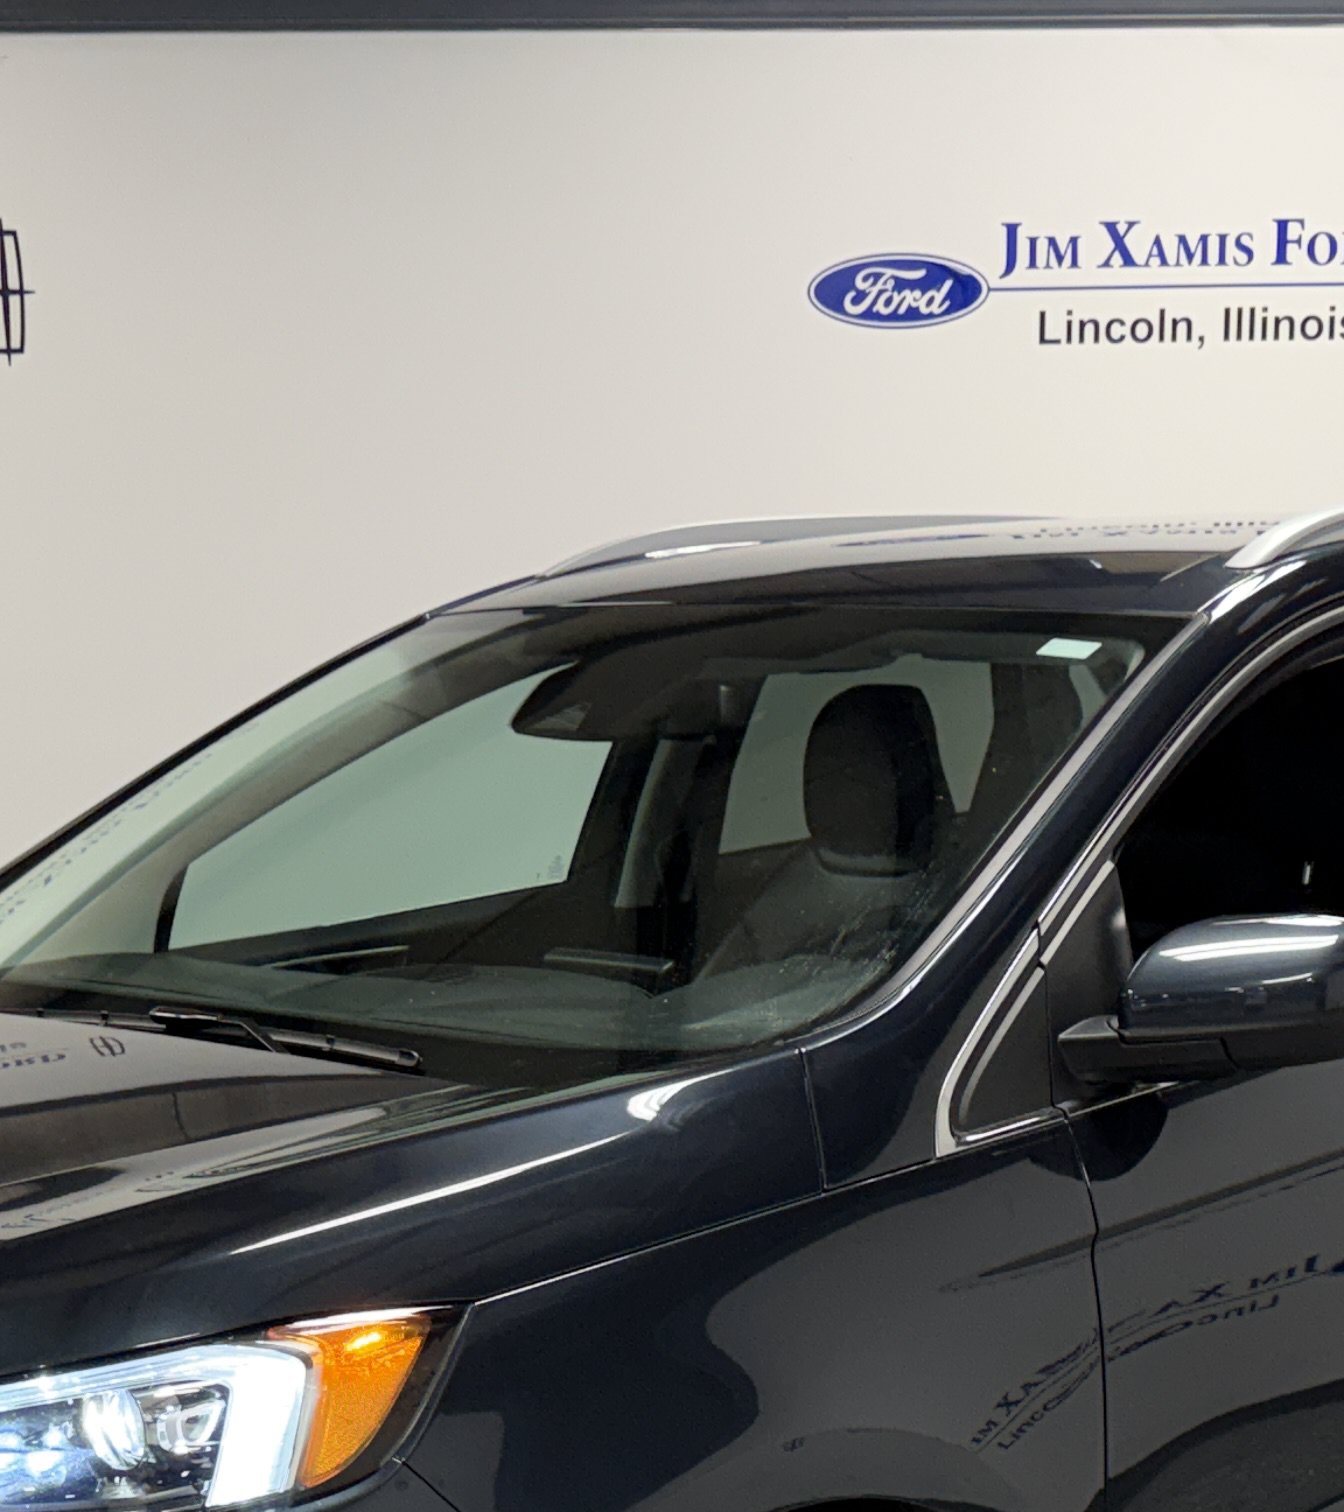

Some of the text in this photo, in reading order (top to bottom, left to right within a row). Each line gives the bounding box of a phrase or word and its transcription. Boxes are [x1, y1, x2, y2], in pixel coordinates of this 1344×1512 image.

[999, 222, 1082, 279] JIM
[1097, 220, 1255, 269] XAMIS
[842, 267, 953, 319] Ford
[1038, 308, 1205, 350] Lincoln,
